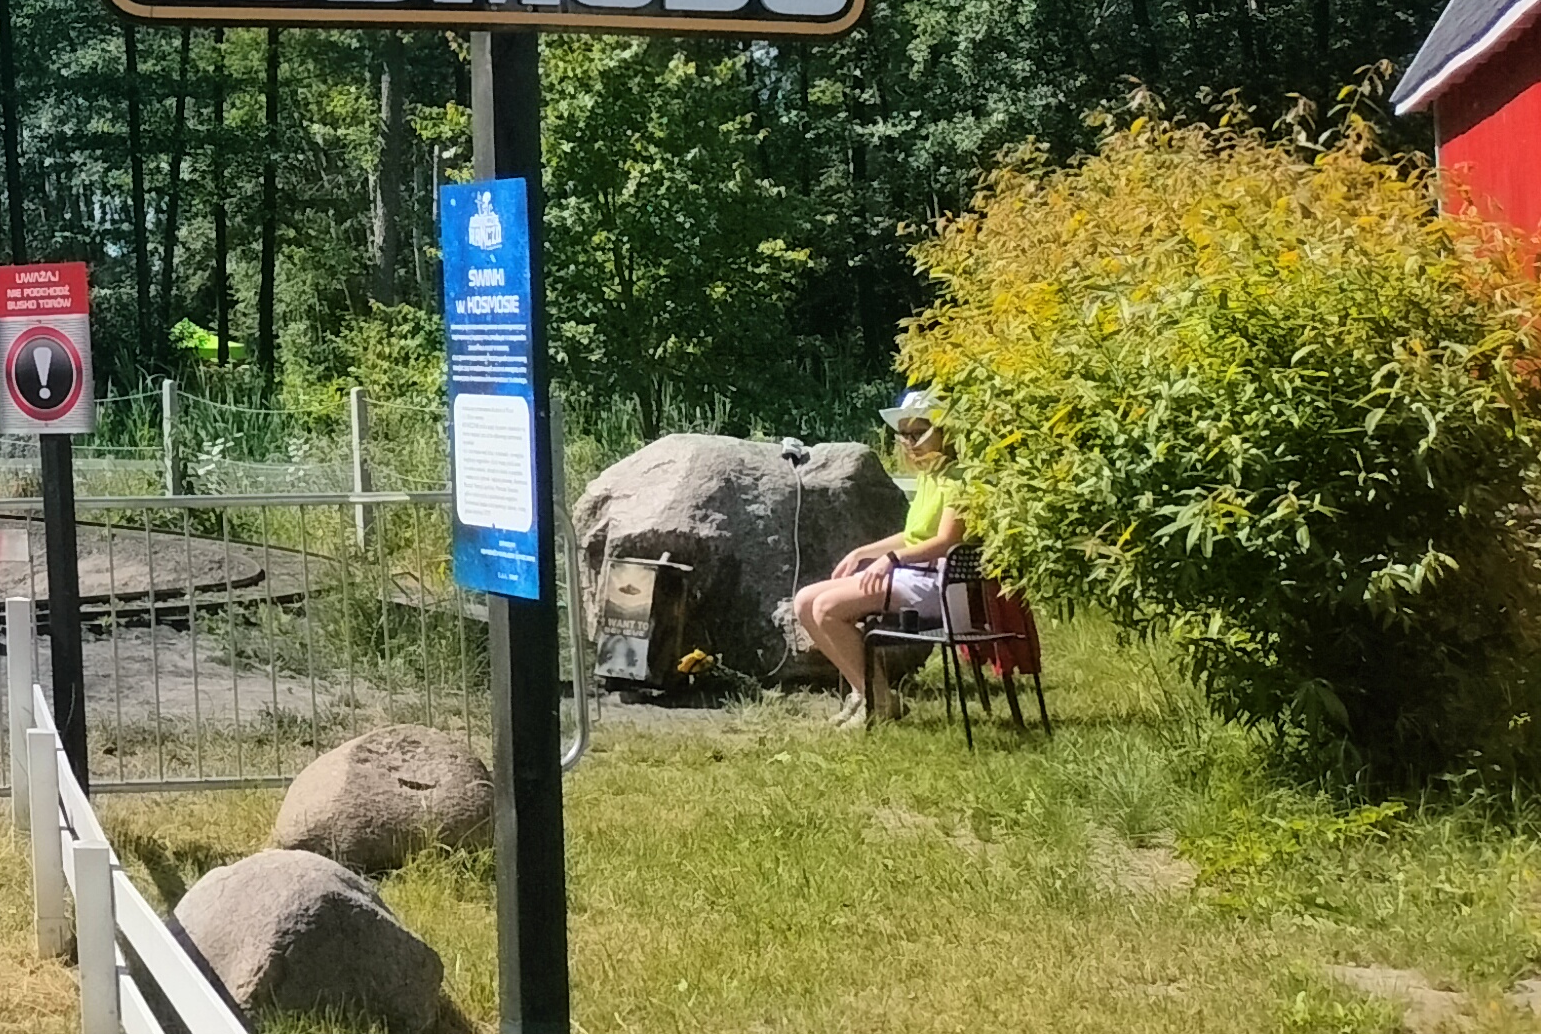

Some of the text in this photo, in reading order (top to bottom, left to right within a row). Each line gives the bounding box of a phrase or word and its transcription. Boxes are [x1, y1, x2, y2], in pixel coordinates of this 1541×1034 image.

[16, 270, 59, 283] UWAŻAJ
[7, 289, 21, 297] NIE
[608, 617, 635, 629] WANT
[637, 621, 649, 631] TO
